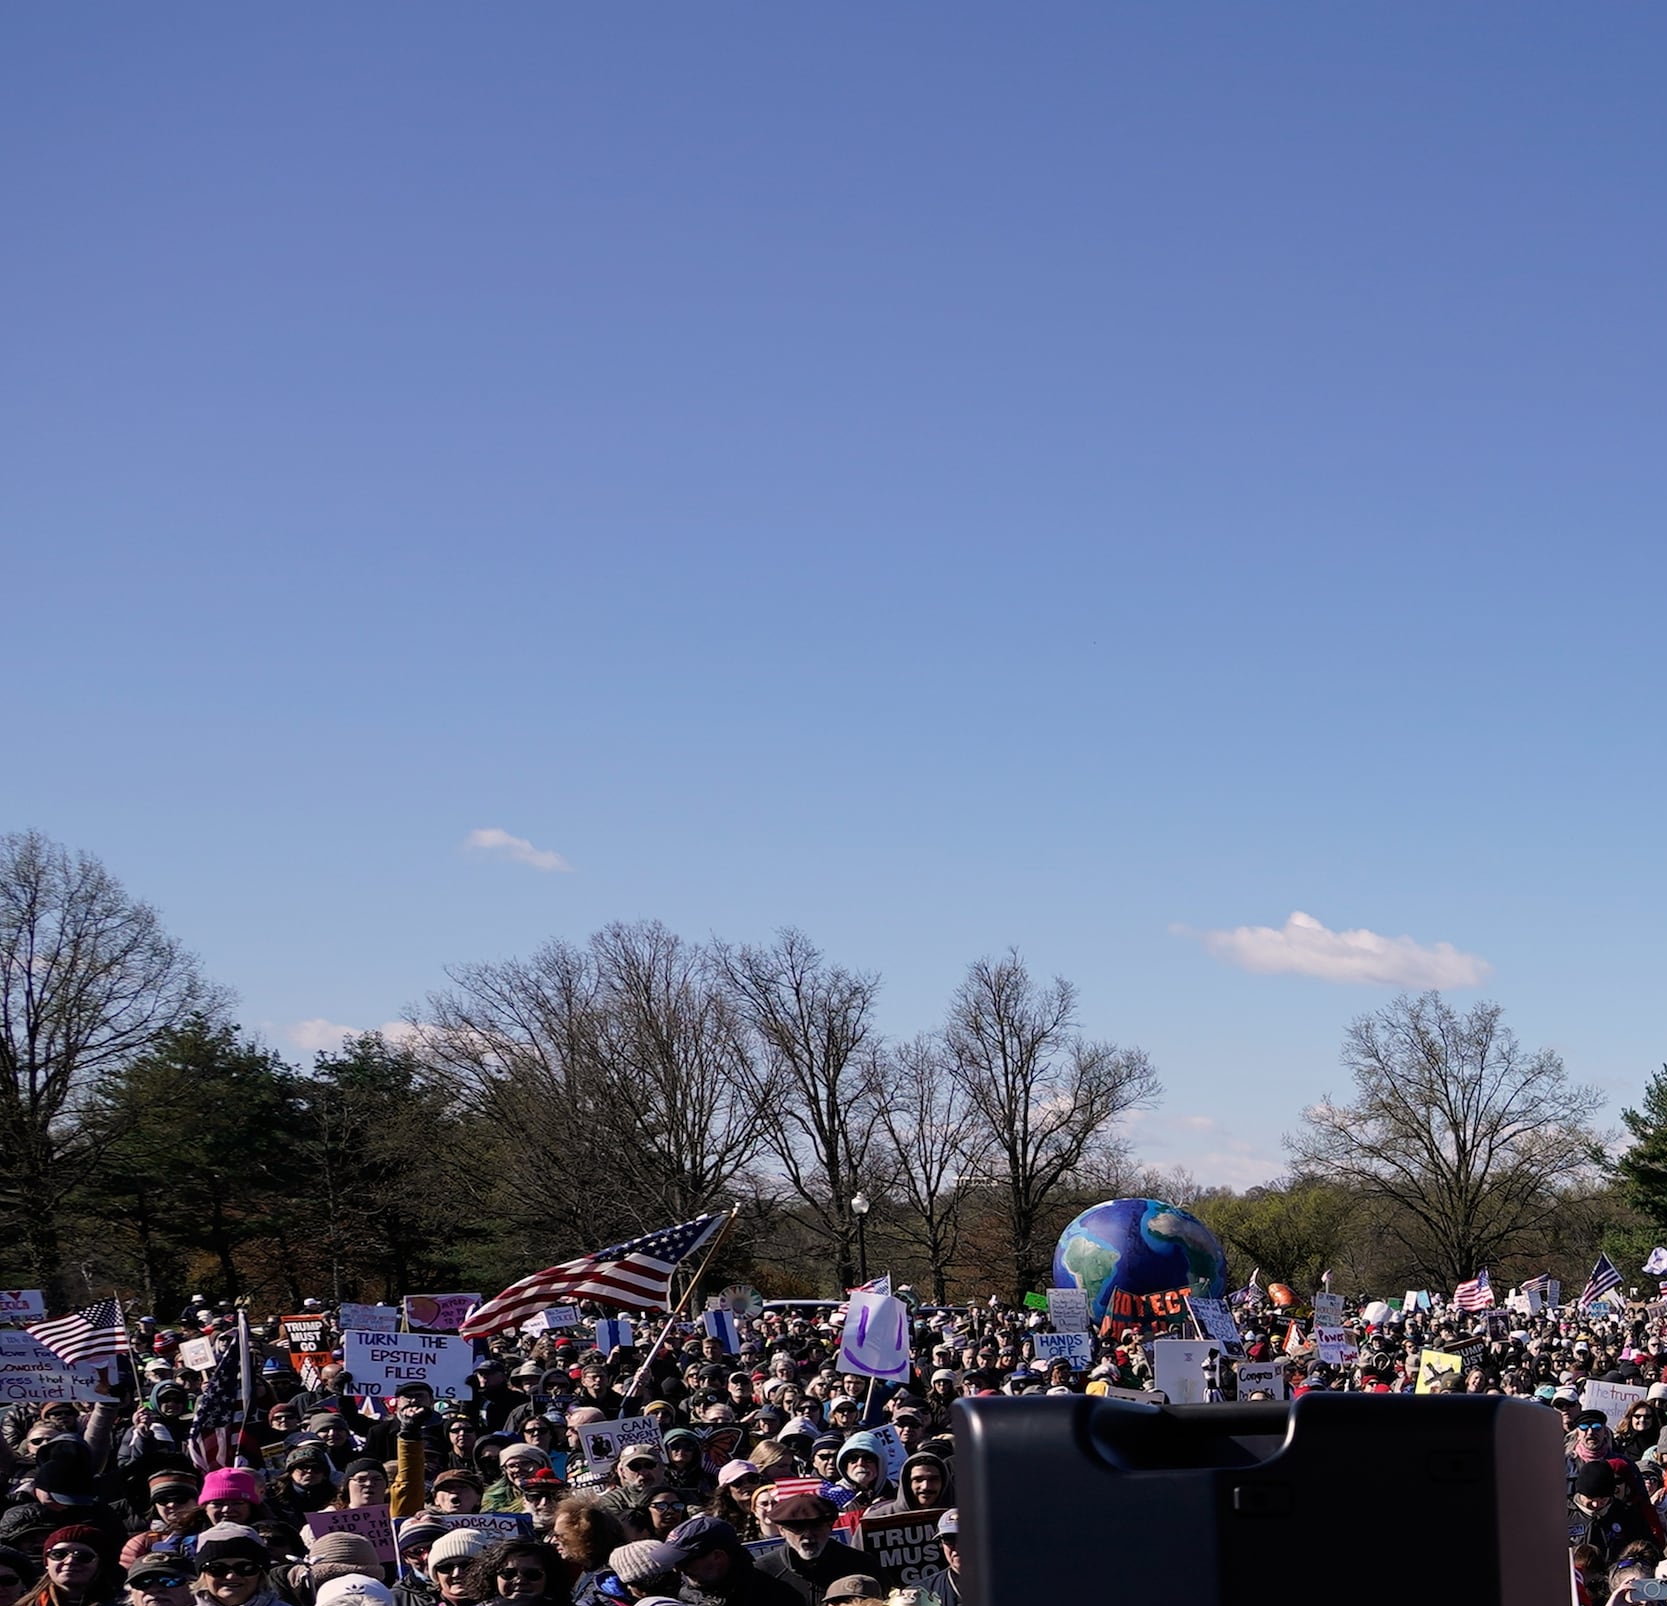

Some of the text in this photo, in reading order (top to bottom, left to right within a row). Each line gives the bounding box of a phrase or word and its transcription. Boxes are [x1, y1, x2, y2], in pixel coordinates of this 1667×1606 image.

[0, 1300, 30, 1311] ERICA
[285, 1321, 323, 1333] TRUMP
[290, 1332, 321, 1342] MUST
[357, 1333, 449, 1349] TURN THE
[1040, 1334, 1083, 1346] HANDS
[300, 1341, 318, 1352] GO
[1051, 1345, 1077, 1357] OFF
[371, 1350, 437, 1365] EPSTEIN
[39, 1373, 64, 1385] that
[385, 1367, 427, 1380] FILES
[346, 1382, 382, 1396] INTO
[621, 1418, 653, 1432] CAN
[332, 1514, 375, 1526] STOP
